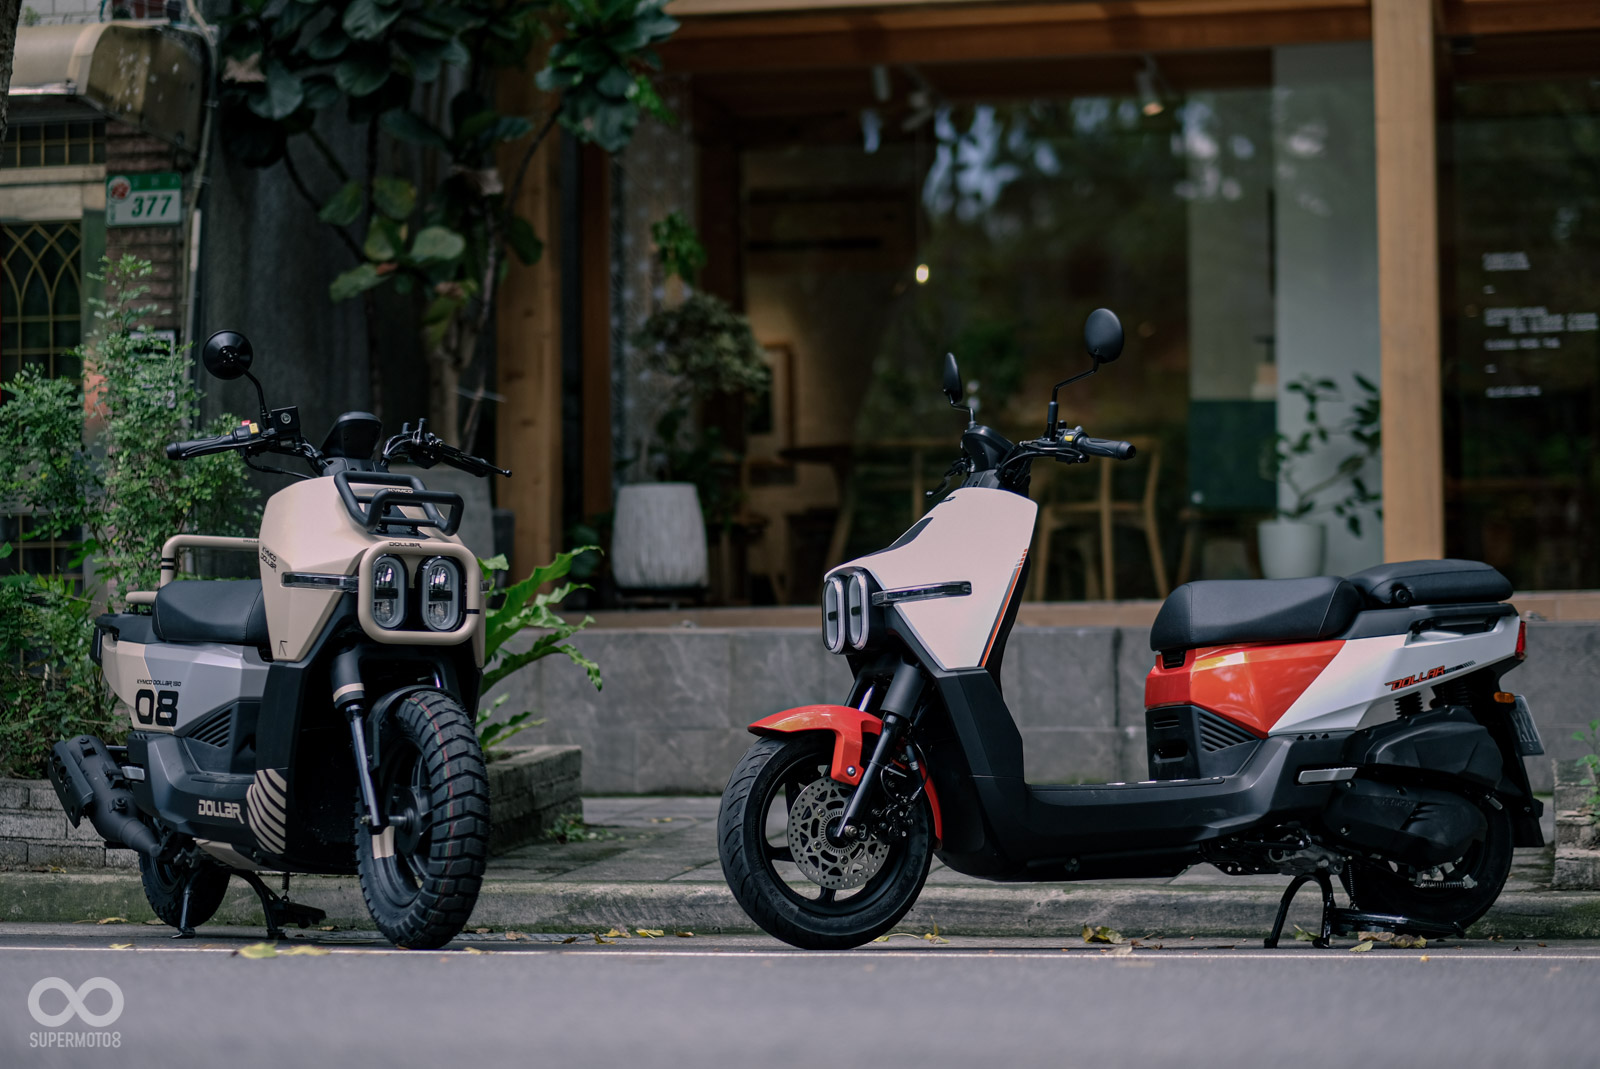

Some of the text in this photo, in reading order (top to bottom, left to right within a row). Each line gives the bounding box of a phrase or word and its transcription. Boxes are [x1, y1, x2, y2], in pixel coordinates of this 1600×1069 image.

[131, 195, 173, 218] 377
[1384, 664, 1445, 691] DOLLAR
[135, 688, 179, 727] 08
